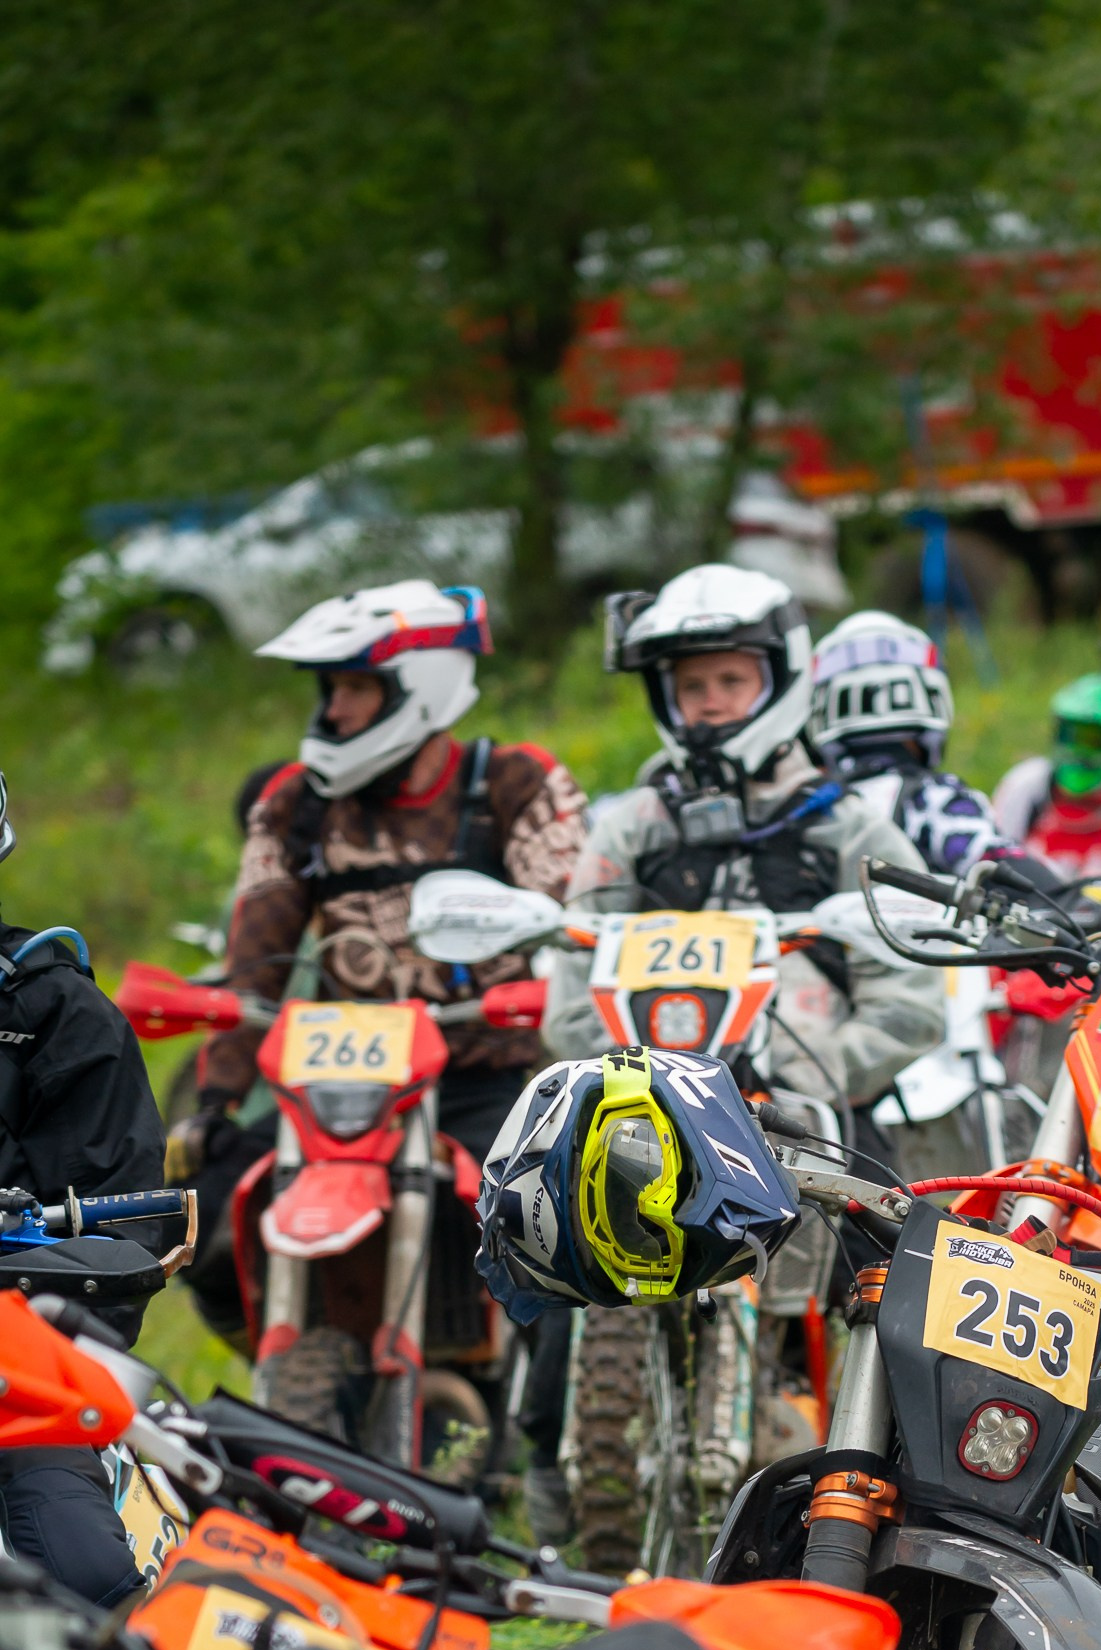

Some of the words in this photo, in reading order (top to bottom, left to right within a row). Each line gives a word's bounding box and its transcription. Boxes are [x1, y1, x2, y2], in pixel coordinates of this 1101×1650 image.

[647, 936, 724, 974] 261
[304, 1030, 387, 1068] 266
[532, 1186, 551, 1255] ACERBIS
[962, 1240, 996, 1257] ТОЧКА
[1058, 1269, 1098, 1299] БРОНЗА
[1072, 1299, 1095, 1317] САМАРА
[1083, 1297, 1096, 1309] 2025
[955, 1278, 1075, 1379] 253
